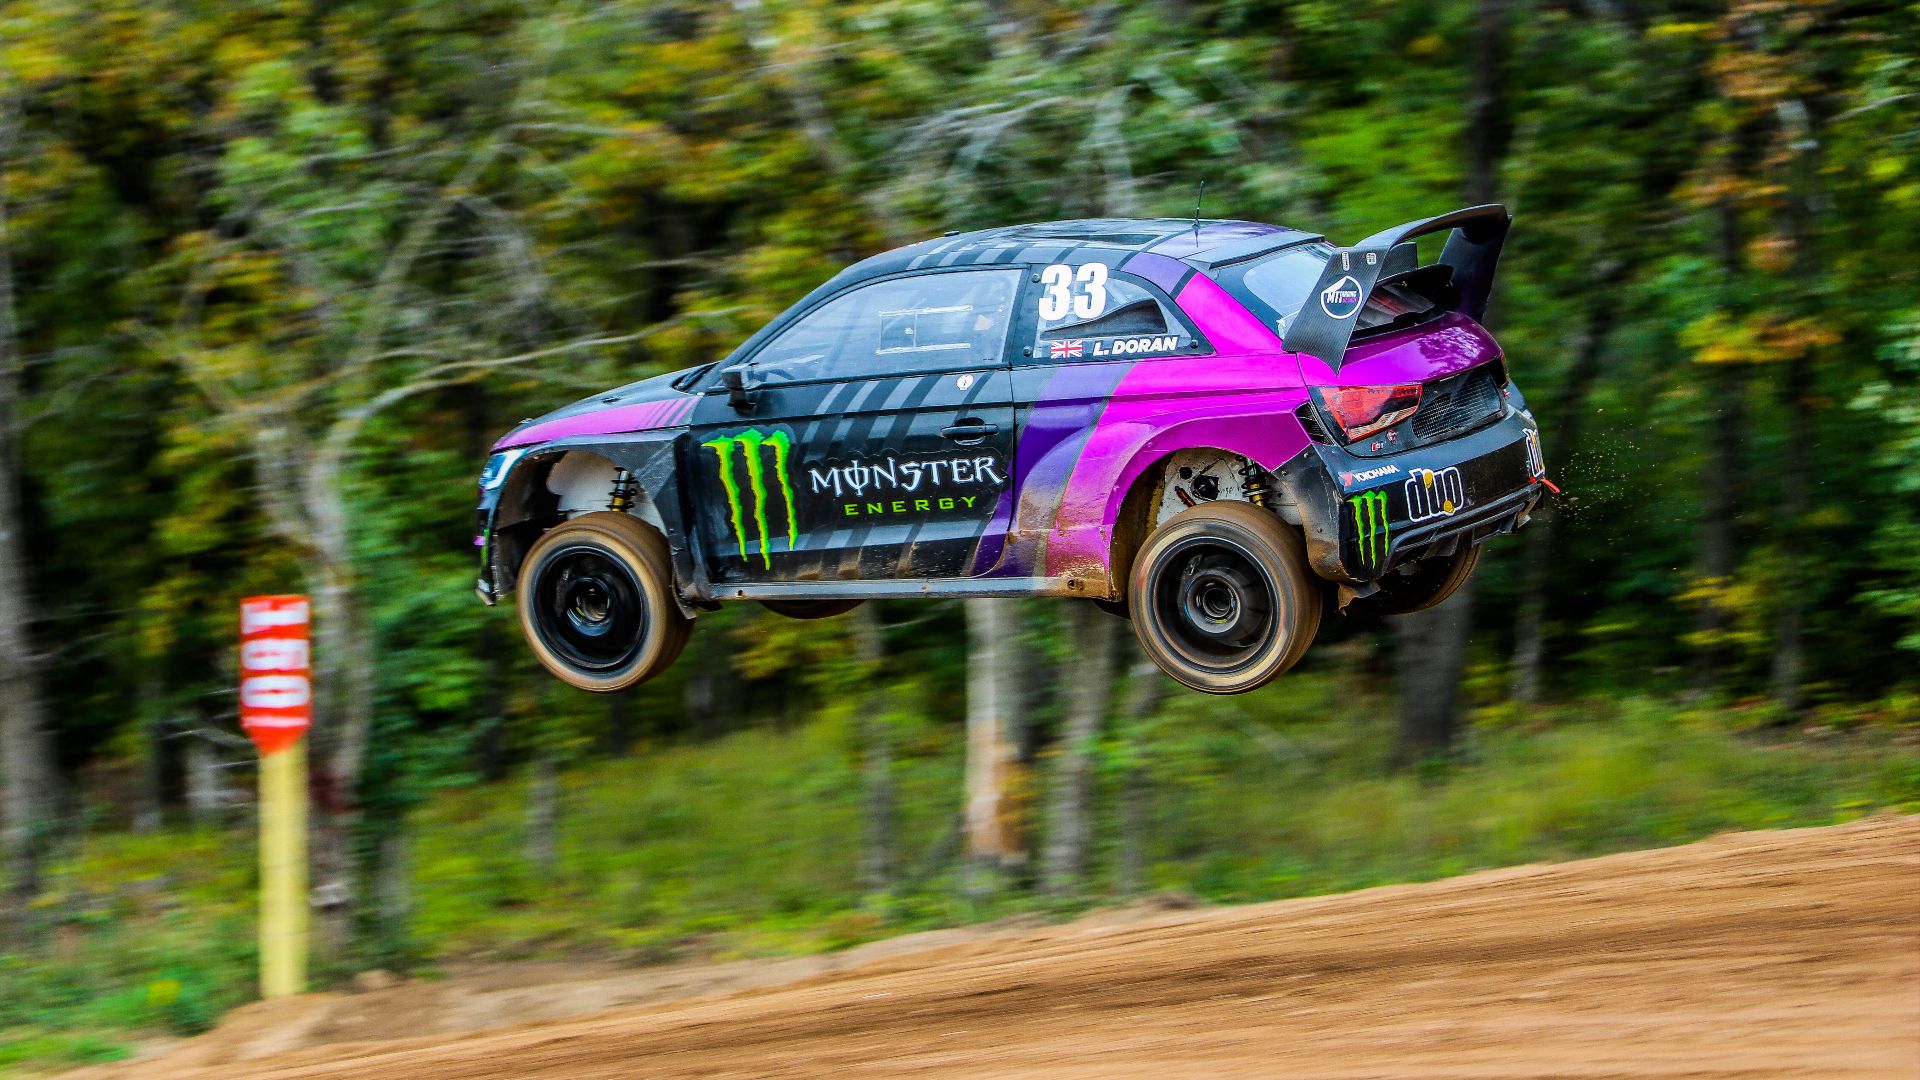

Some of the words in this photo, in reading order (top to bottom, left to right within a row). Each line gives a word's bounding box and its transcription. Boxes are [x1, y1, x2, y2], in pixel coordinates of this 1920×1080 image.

[1038, 262, 1108, 321] 33
[808, 456, 1008, 498] MONSTER
[1352, 464, 1400, 482] YOKOHAMA
[843, 496, 977, 516] ENERGY
